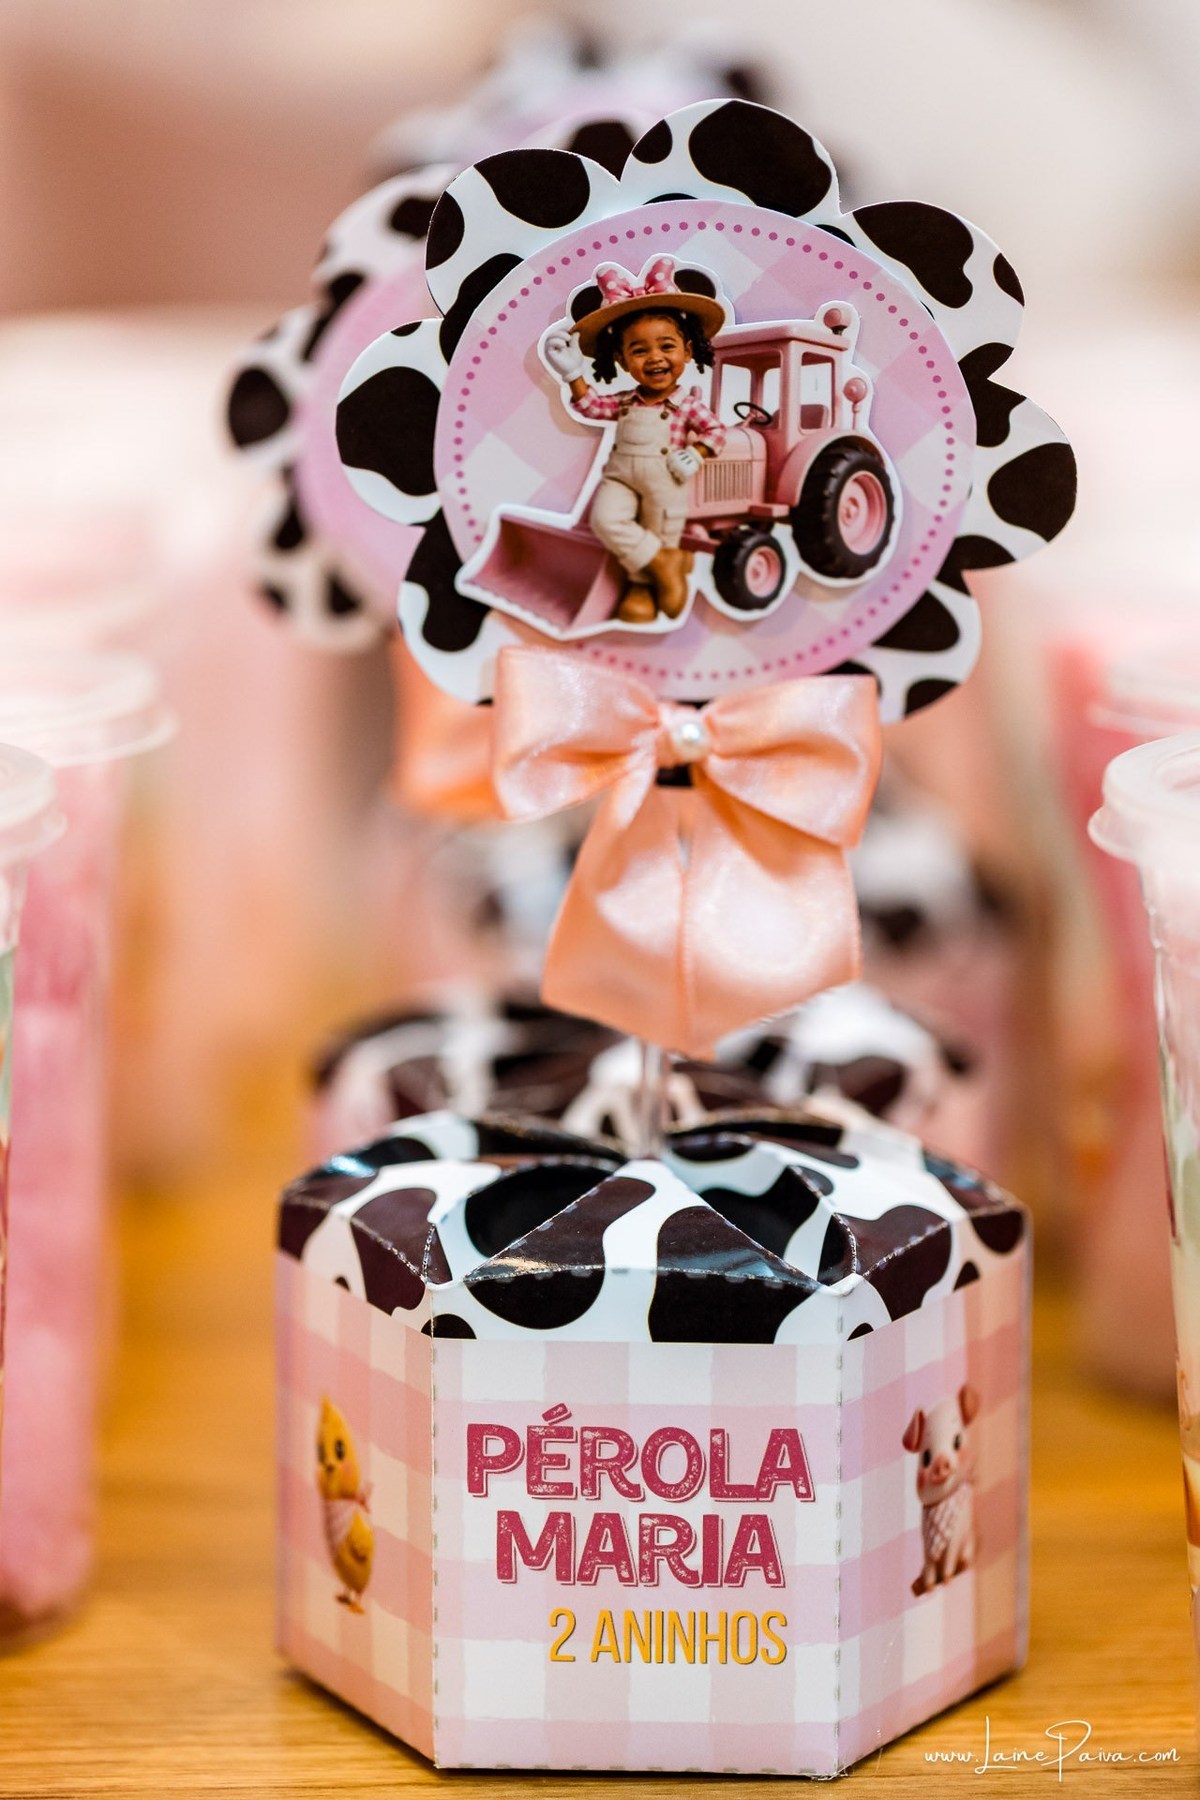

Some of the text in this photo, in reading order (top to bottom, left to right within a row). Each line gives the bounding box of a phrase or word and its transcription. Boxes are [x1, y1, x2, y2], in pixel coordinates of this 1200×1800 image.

[467, 1402, 816, 1502] PÉROLA
[496, 1510, 786, 1588] MARIA
[548, 1608, 788, 1665] 2 ANINHOS
